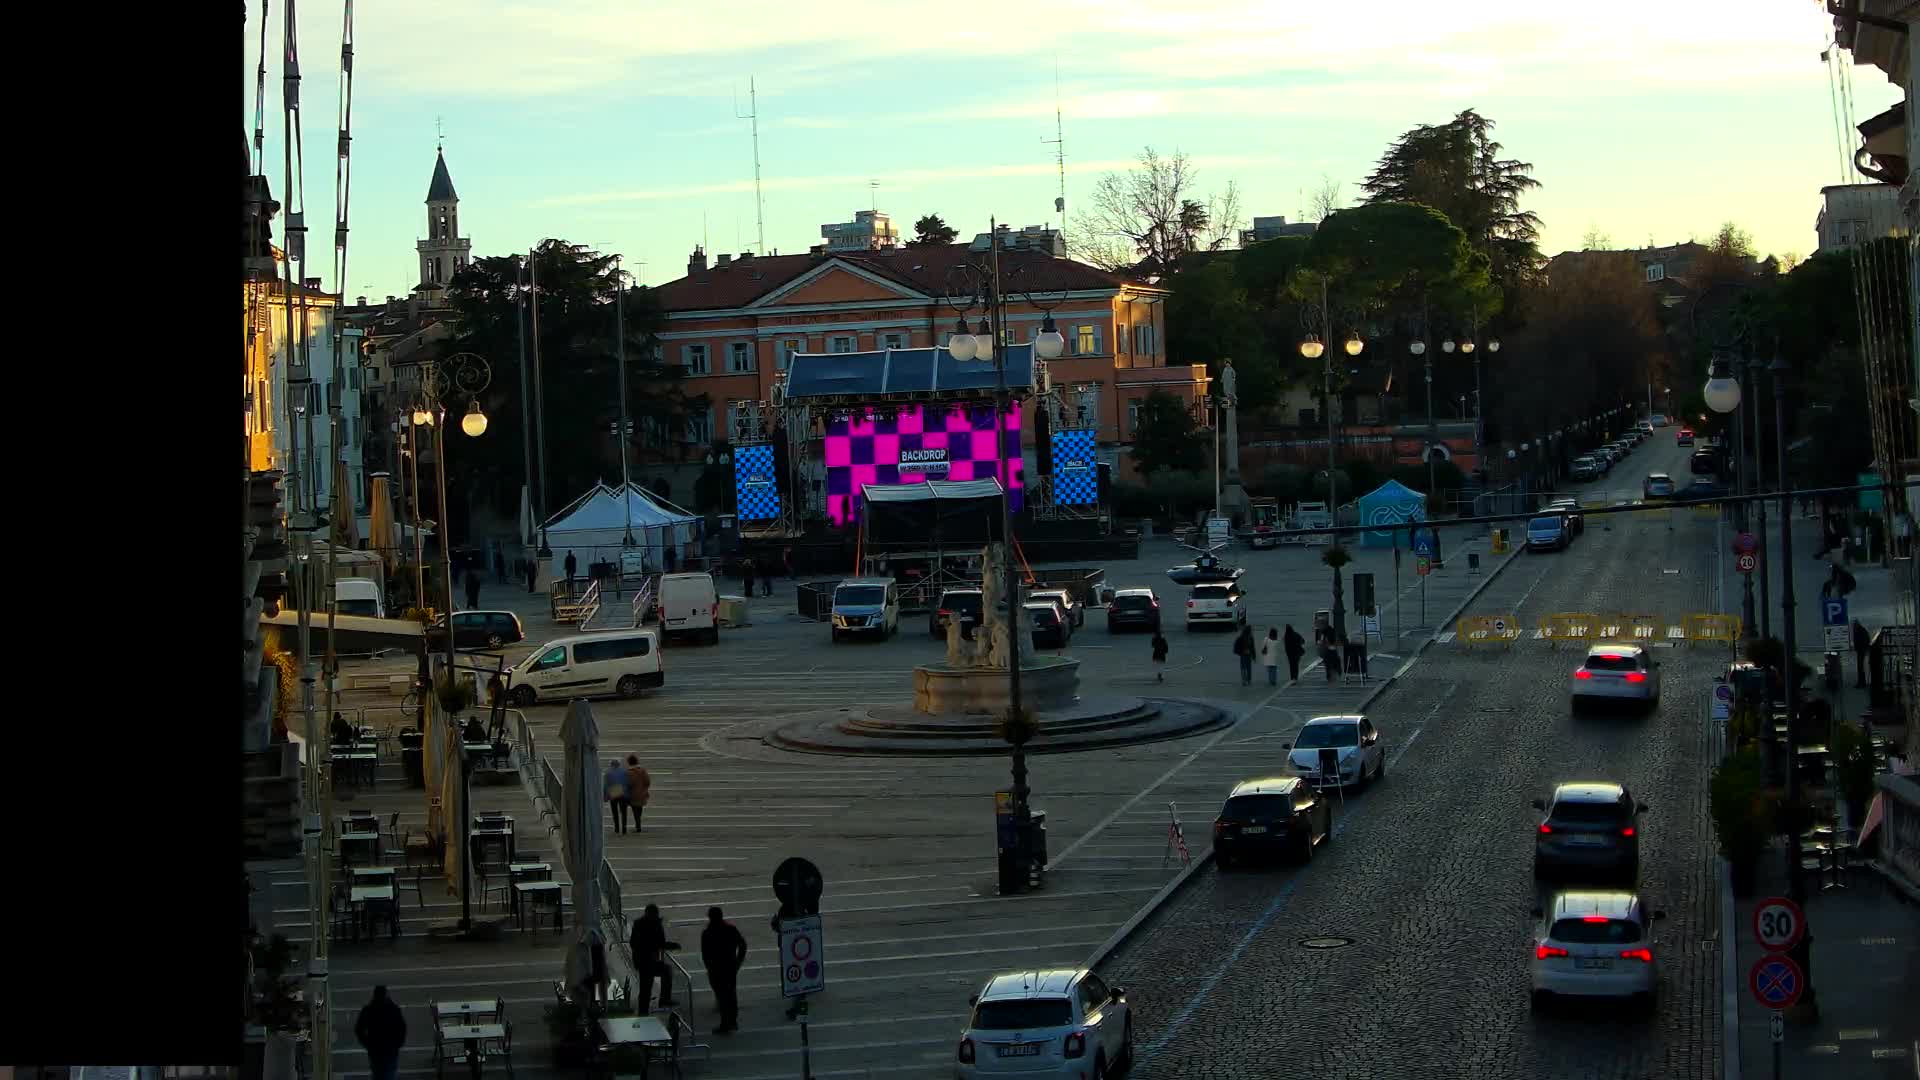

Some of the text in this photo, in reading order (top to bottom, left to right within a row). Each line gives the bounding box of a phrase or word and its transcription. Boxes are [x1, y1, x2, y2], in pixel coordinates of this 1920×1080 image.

[901, 449, 946, 461] BACKDROP
[1742, 557, 1753, 567] 20
[1827, 602, 1842, 624] P
[1762, 911, 1791, 938] 30
